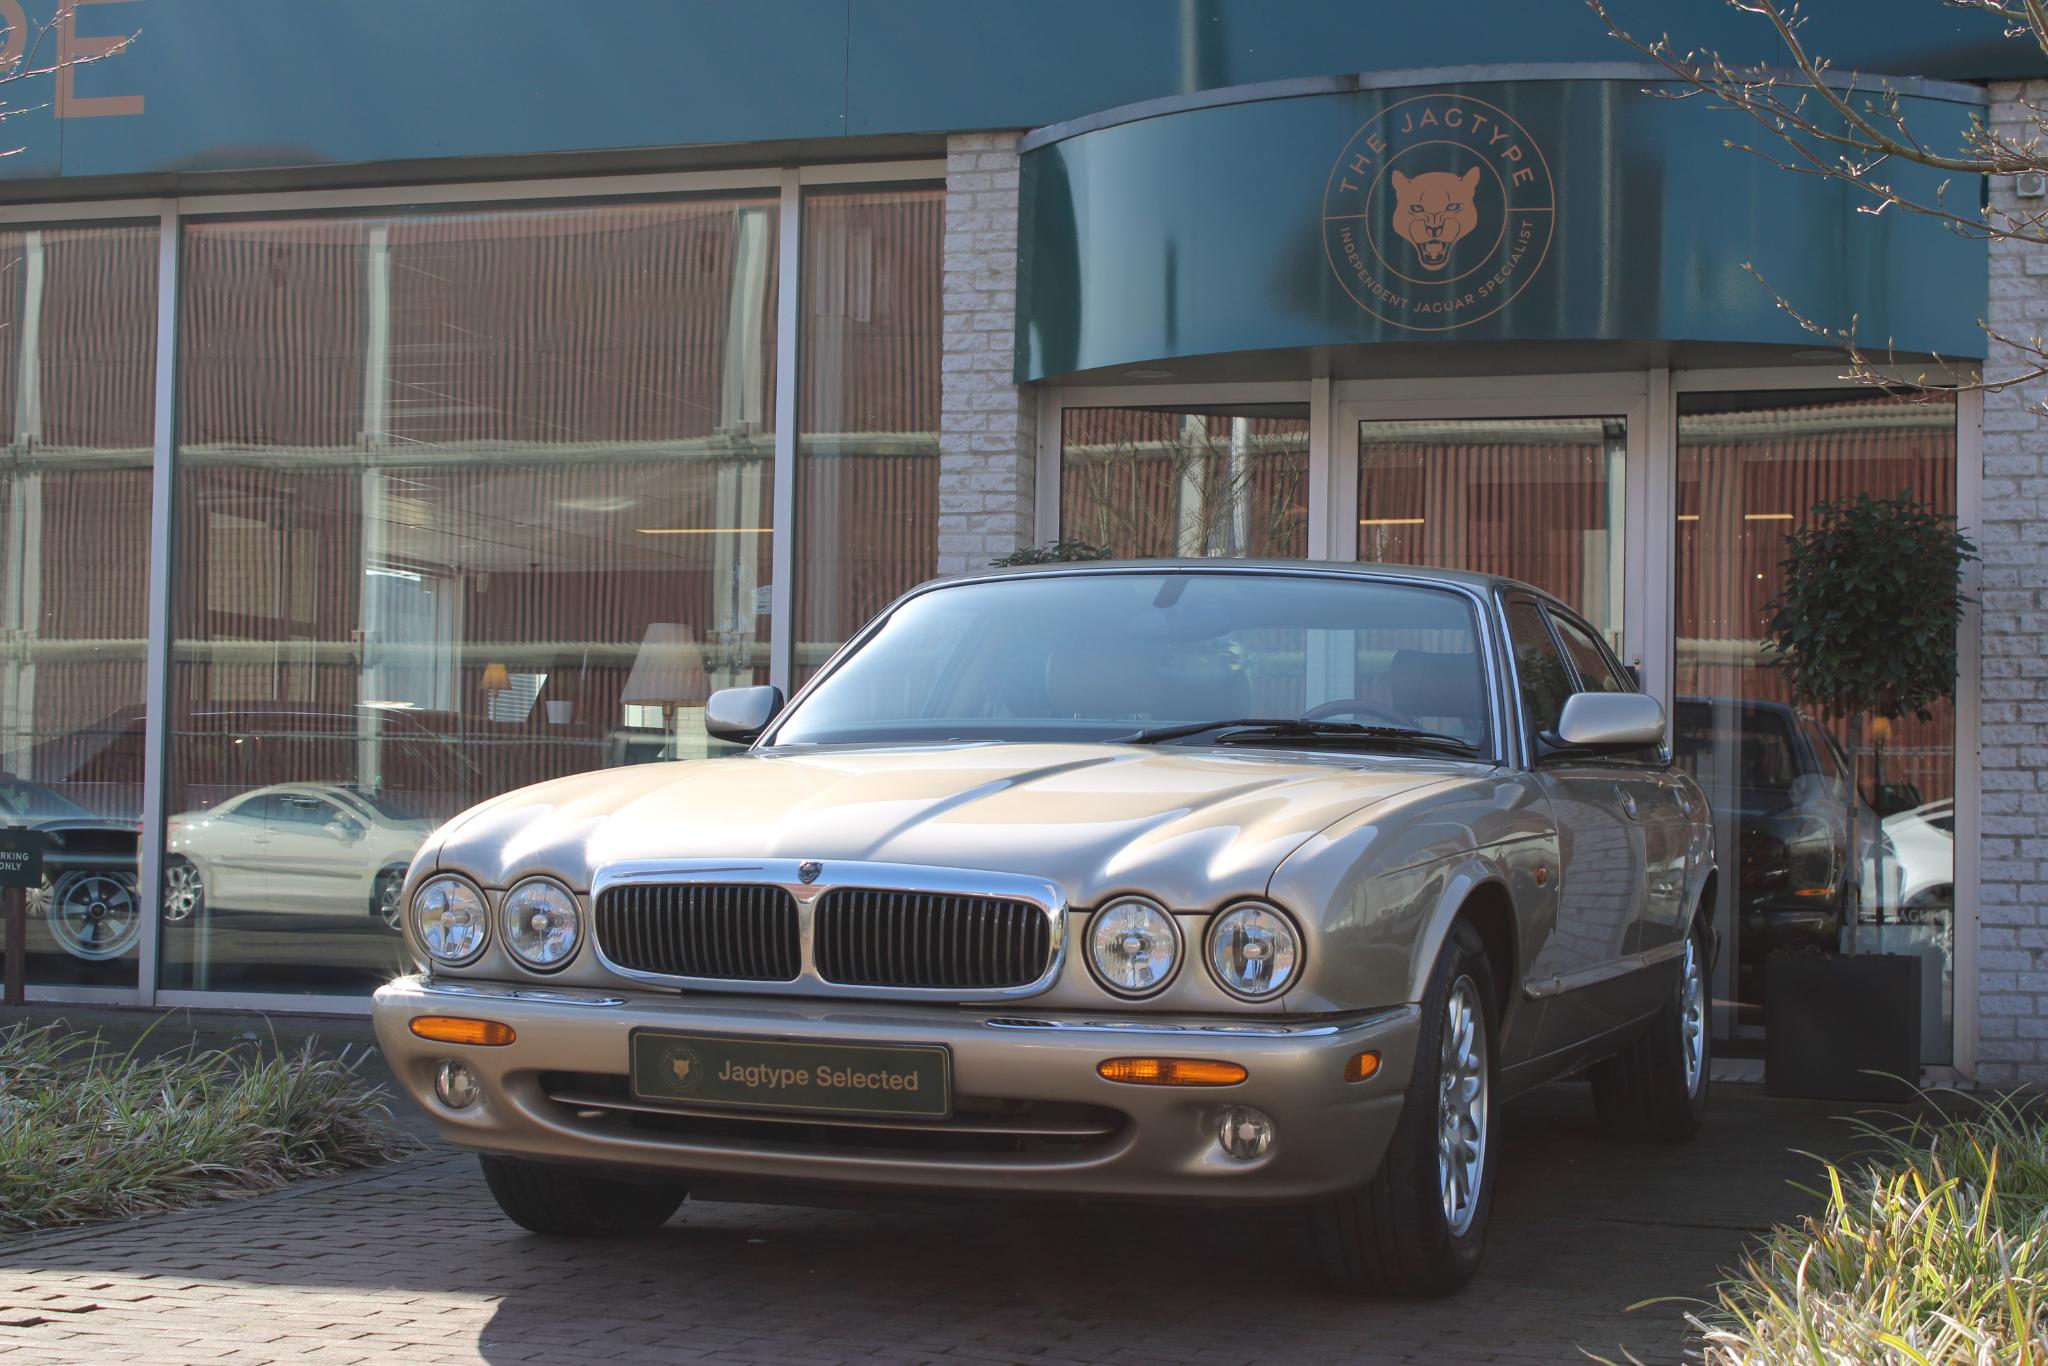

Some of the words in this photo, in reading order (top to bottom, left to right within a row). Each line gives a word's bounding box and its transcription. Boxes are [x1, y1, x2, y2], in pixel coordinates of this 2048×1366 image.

[1340, 132, 1387, 193] THE
[1401, 108, 1534, 187] JAGTYPE
[1341, 227, 1409, 307] INDEPENDENT
[1413, 294, 1475, 313] JAGUAR
[1478, 220, 1534, 296] SPECIALIST
[0, 861, 22, 871] ONLY
[719, 1060, 809, 1088] Jagtype
[816, 1065, 918, 1091] Selected
